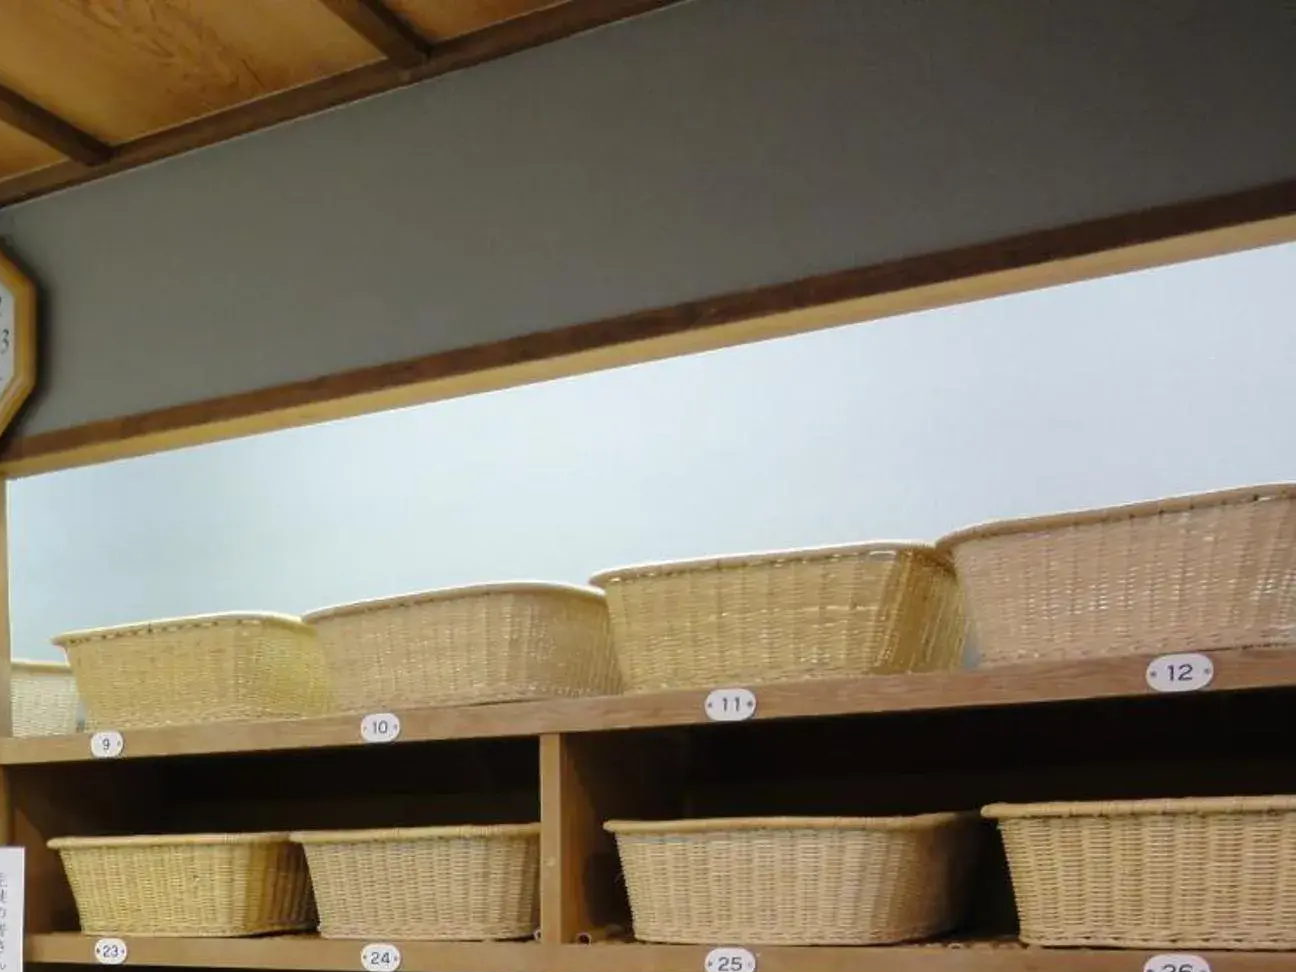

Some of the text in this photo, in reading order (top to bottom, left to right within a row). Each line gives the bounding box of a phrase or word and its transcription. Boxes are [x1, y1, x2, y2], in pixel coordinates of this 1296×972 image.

[1, 329, 10, 354] 3
[1167, 664, 1193, 681] 12
[723, 697, 740, 711] 11
[373, 720, 388, 734] 10
[103, 738, 110, 750] 9
[103, 945, 118, 958] 23
[371, 952, 390, 964] 24
[718, 957, 742, 972] 25
